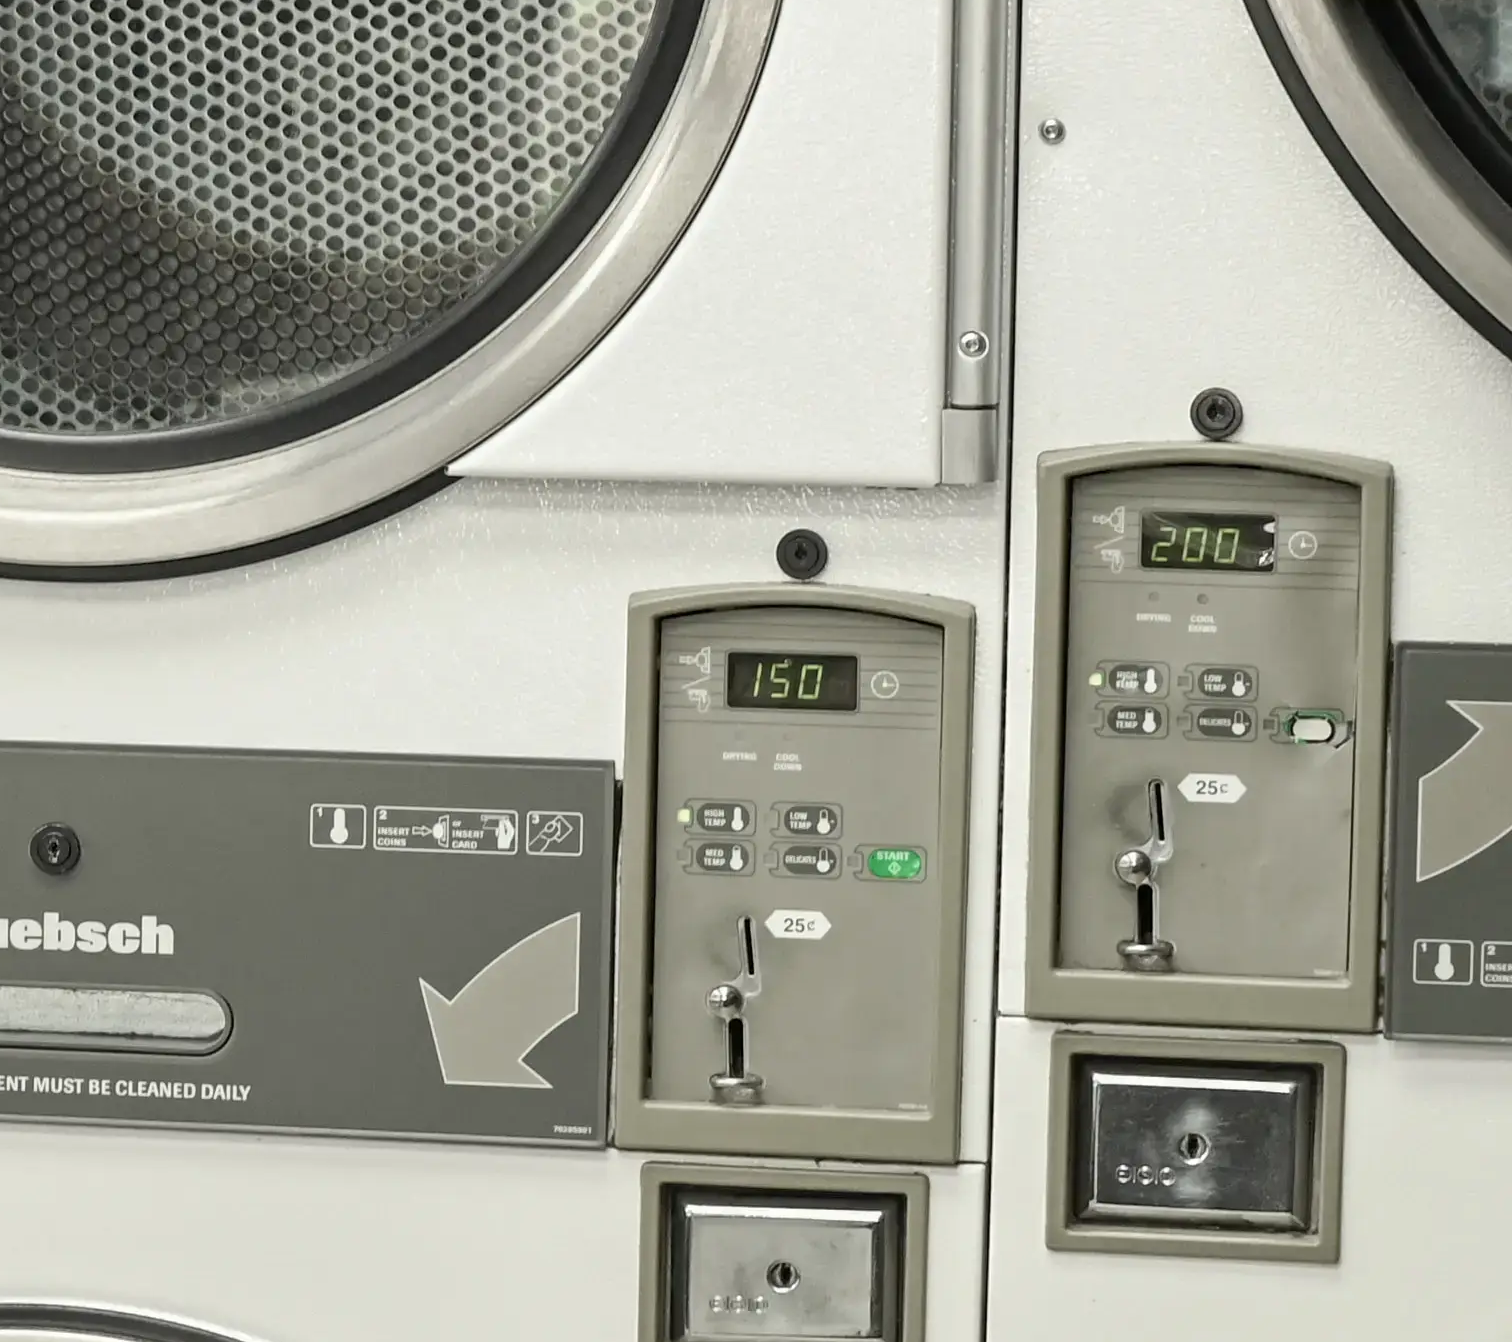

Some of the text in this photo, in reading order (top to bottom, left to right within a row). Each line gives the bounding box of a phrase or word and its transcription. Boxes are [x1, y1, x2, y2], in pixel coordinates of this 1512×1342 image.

[1151, 526, 1240, 564] 200
[1190, 614, 1216, 624] COOL
[752, 662, 824, 700] 150
[1204, 674, 1222, 684] LOW
[1204, 682, 1227, 692] TEMP
[1117, 711, 1136, 720] MED
[1115, 719, 1138, 730] TEMP
[379, 810, 387, 820] 2
[531, 814, 540, 824] 3
[790, 811, 808, 821] LOW
[704, 817, 727, 827] TEMP
[790, 820, 812, 830] TEMP
[377, 826, 410, 836] INSERT
[452, 829, 485, 839] INSERT
[452, 839, 478, 849] CARD
[705, 849, 724, 858] MED
[876, 850, 910, 861] START
[704, 857, 726, 867] TEMP
[1420, 942, 1427, 952] 1
[1486, 945, 1496, 956] 2
[33, 1077, 84, 1096] MUST
[88, 1079, 110, 1096] BE
[115, 1080, 196, 1100] CLEANED
[200, 1083, 251, 1102] DAILY
